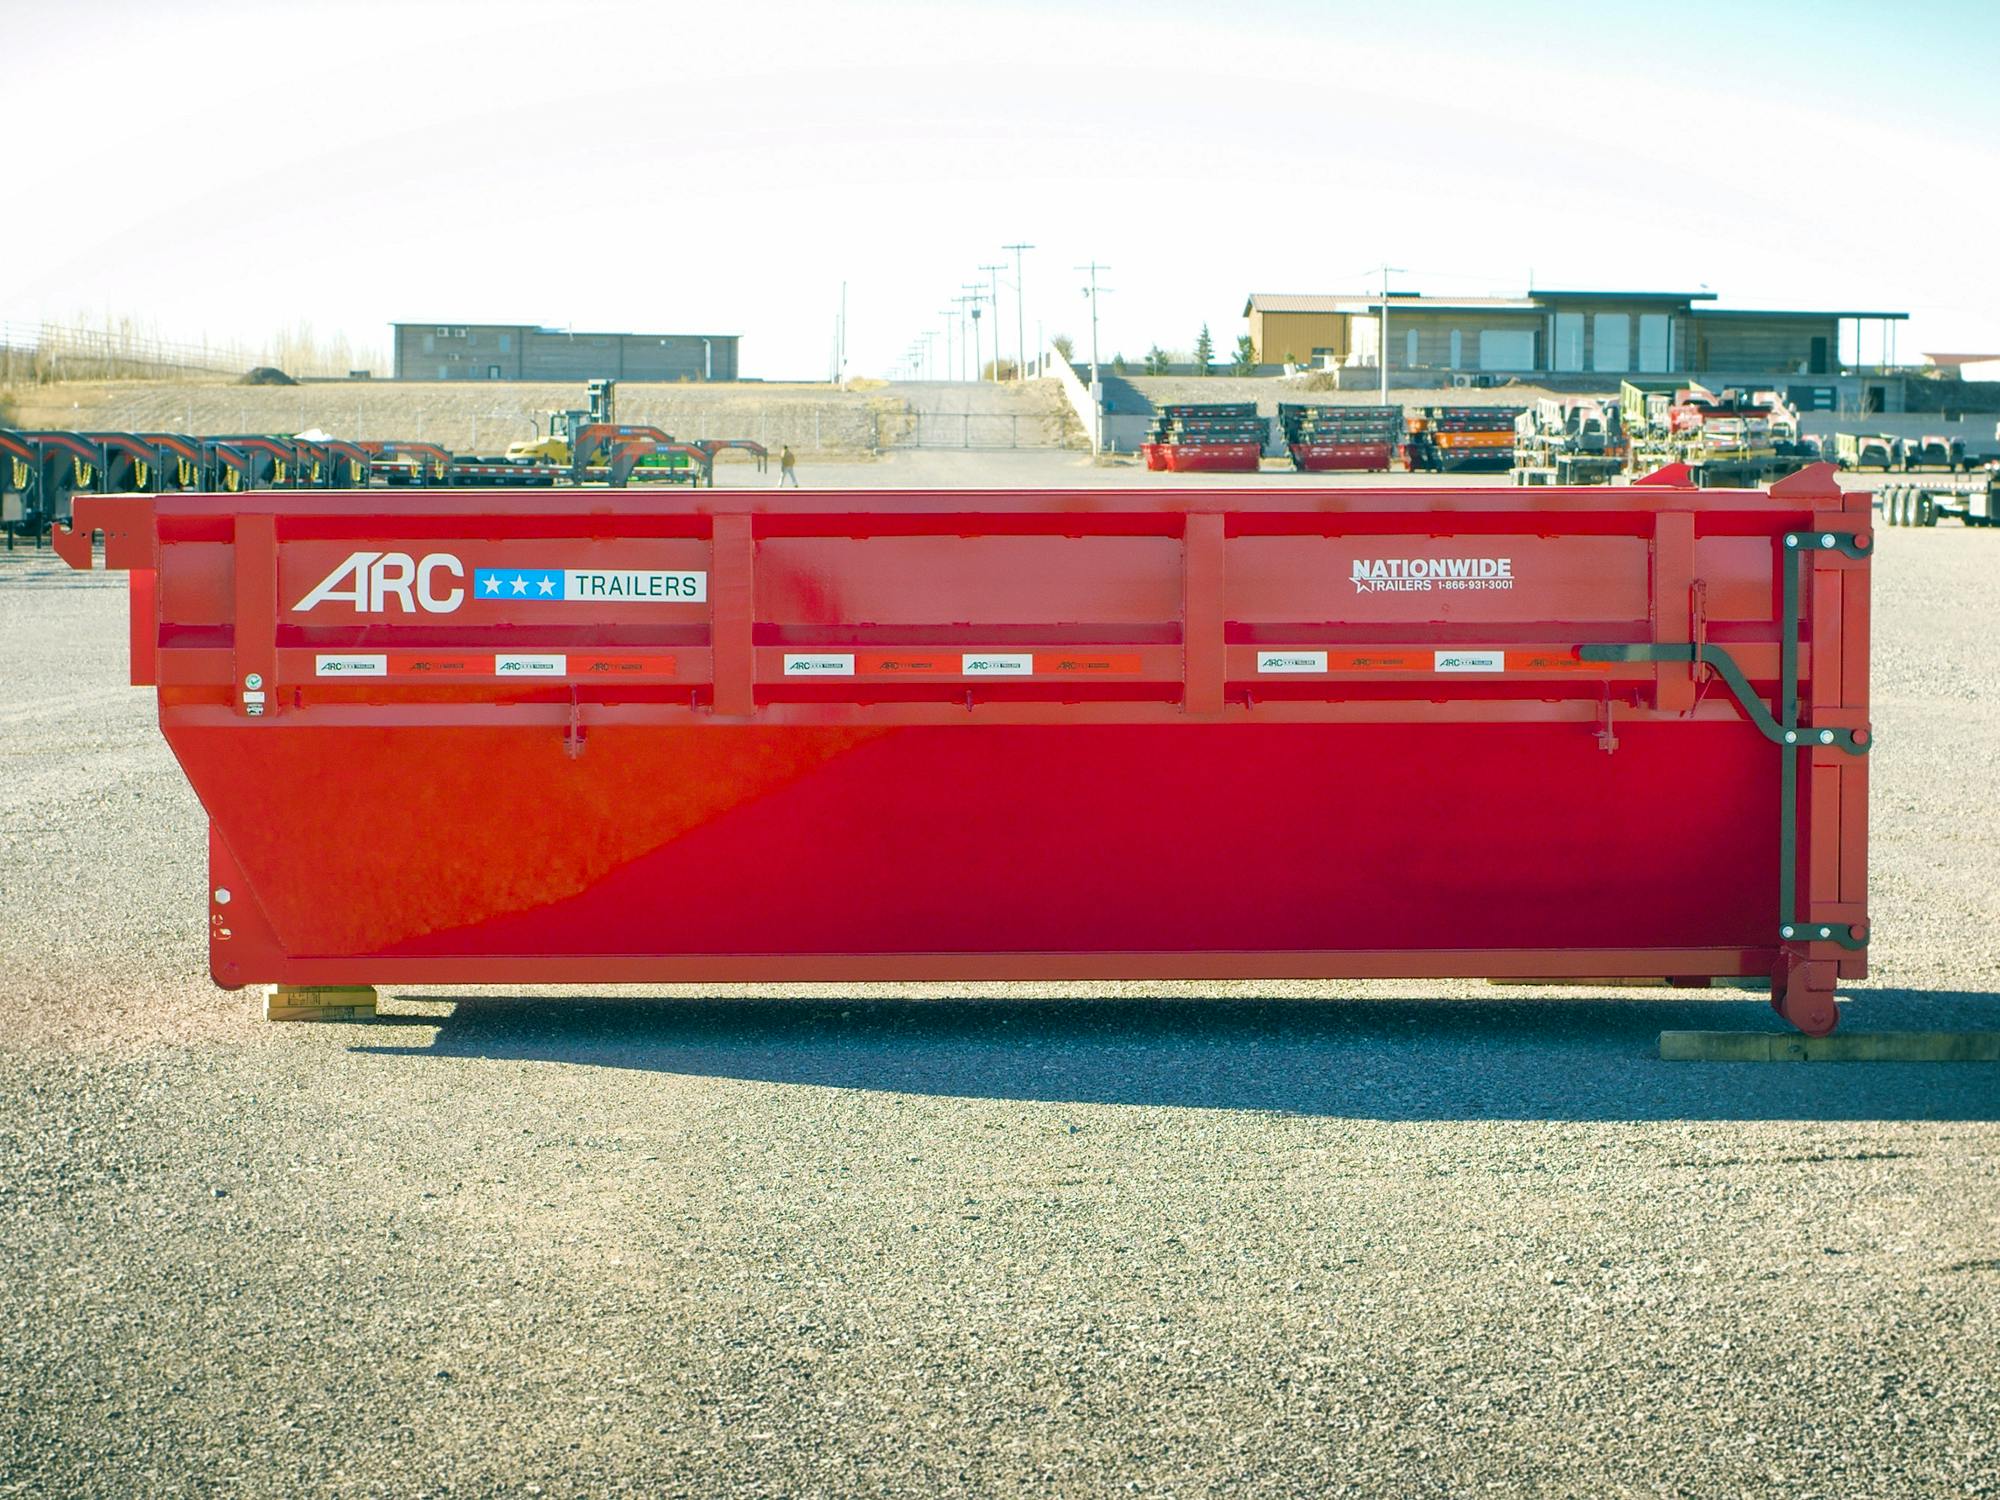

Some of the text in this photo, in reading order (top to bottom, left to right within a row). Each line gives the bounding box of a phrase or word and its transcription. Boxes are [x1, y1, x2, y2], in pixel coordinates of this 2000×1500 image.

[1352, 558, 1513, 579] NATIONWIDE
[291, 551, 697, 613] ARC TRAILERS
[1368, 580, 1514, 591] TRAILERS 1-866-931-3001
[321, 662, 342, 671] ARC
[499, 662, 521, 671] ARC
[789, 661, 810, 670] ARC
[967, 661, 989, 670] ARC
[1262, 658, 1284, 667] ARC
[1439, 658, 1461, 667] ARC
